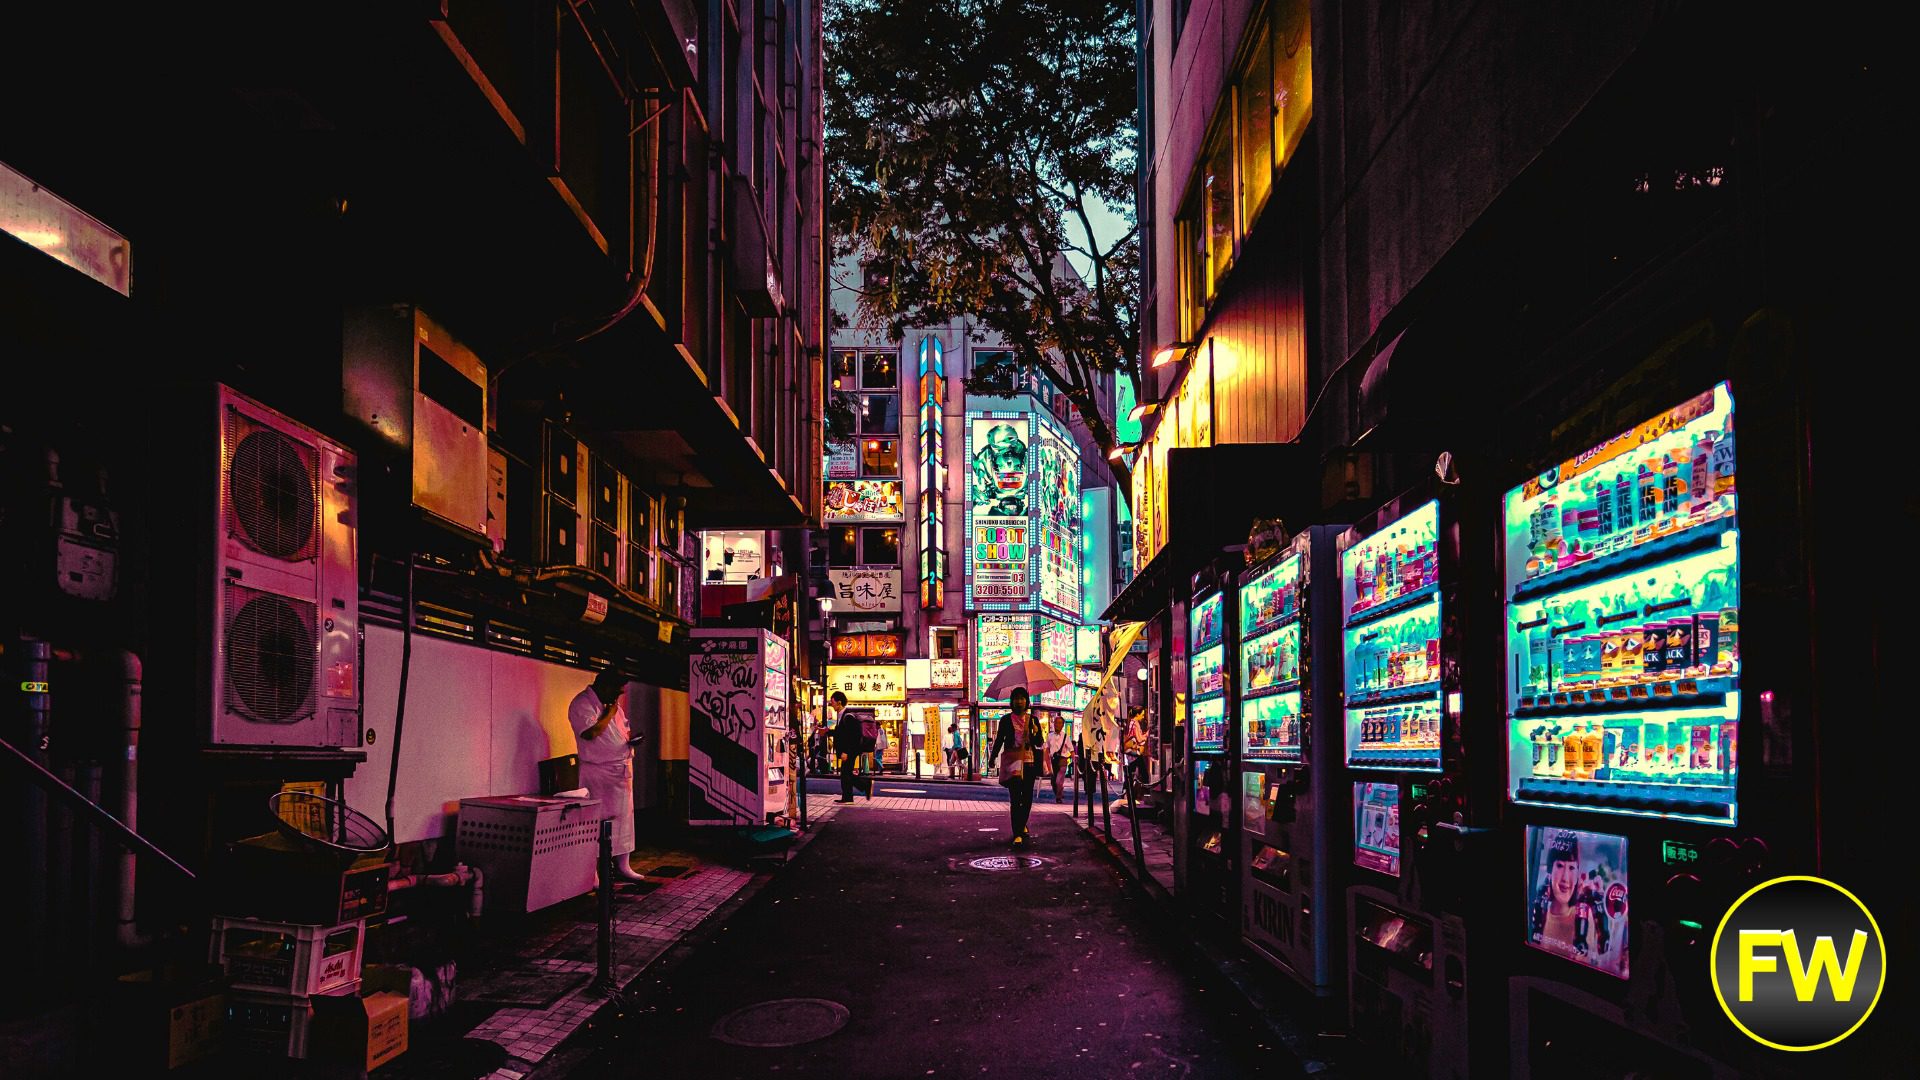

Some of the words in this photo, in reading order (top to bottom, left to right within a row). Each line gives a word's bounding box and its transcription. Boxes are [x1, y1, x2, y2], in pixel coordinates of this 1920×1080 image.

[928, 394, 934, 406] 5
[928, 453, 935, 466] 4
[929, 512, 935, 525] 3
[976, 528, 1025, 543] ROBOT
[976, 544, 1025, 559] SHOW
[929, 571, 935, 584] 2
[1013, 573, 1024, 582] 03
[839, 582, 897, 600] 旨味屋
[829, 681, 896, 692] 三田製麺所
[1254, 889, 1294, 948] KIRIN
